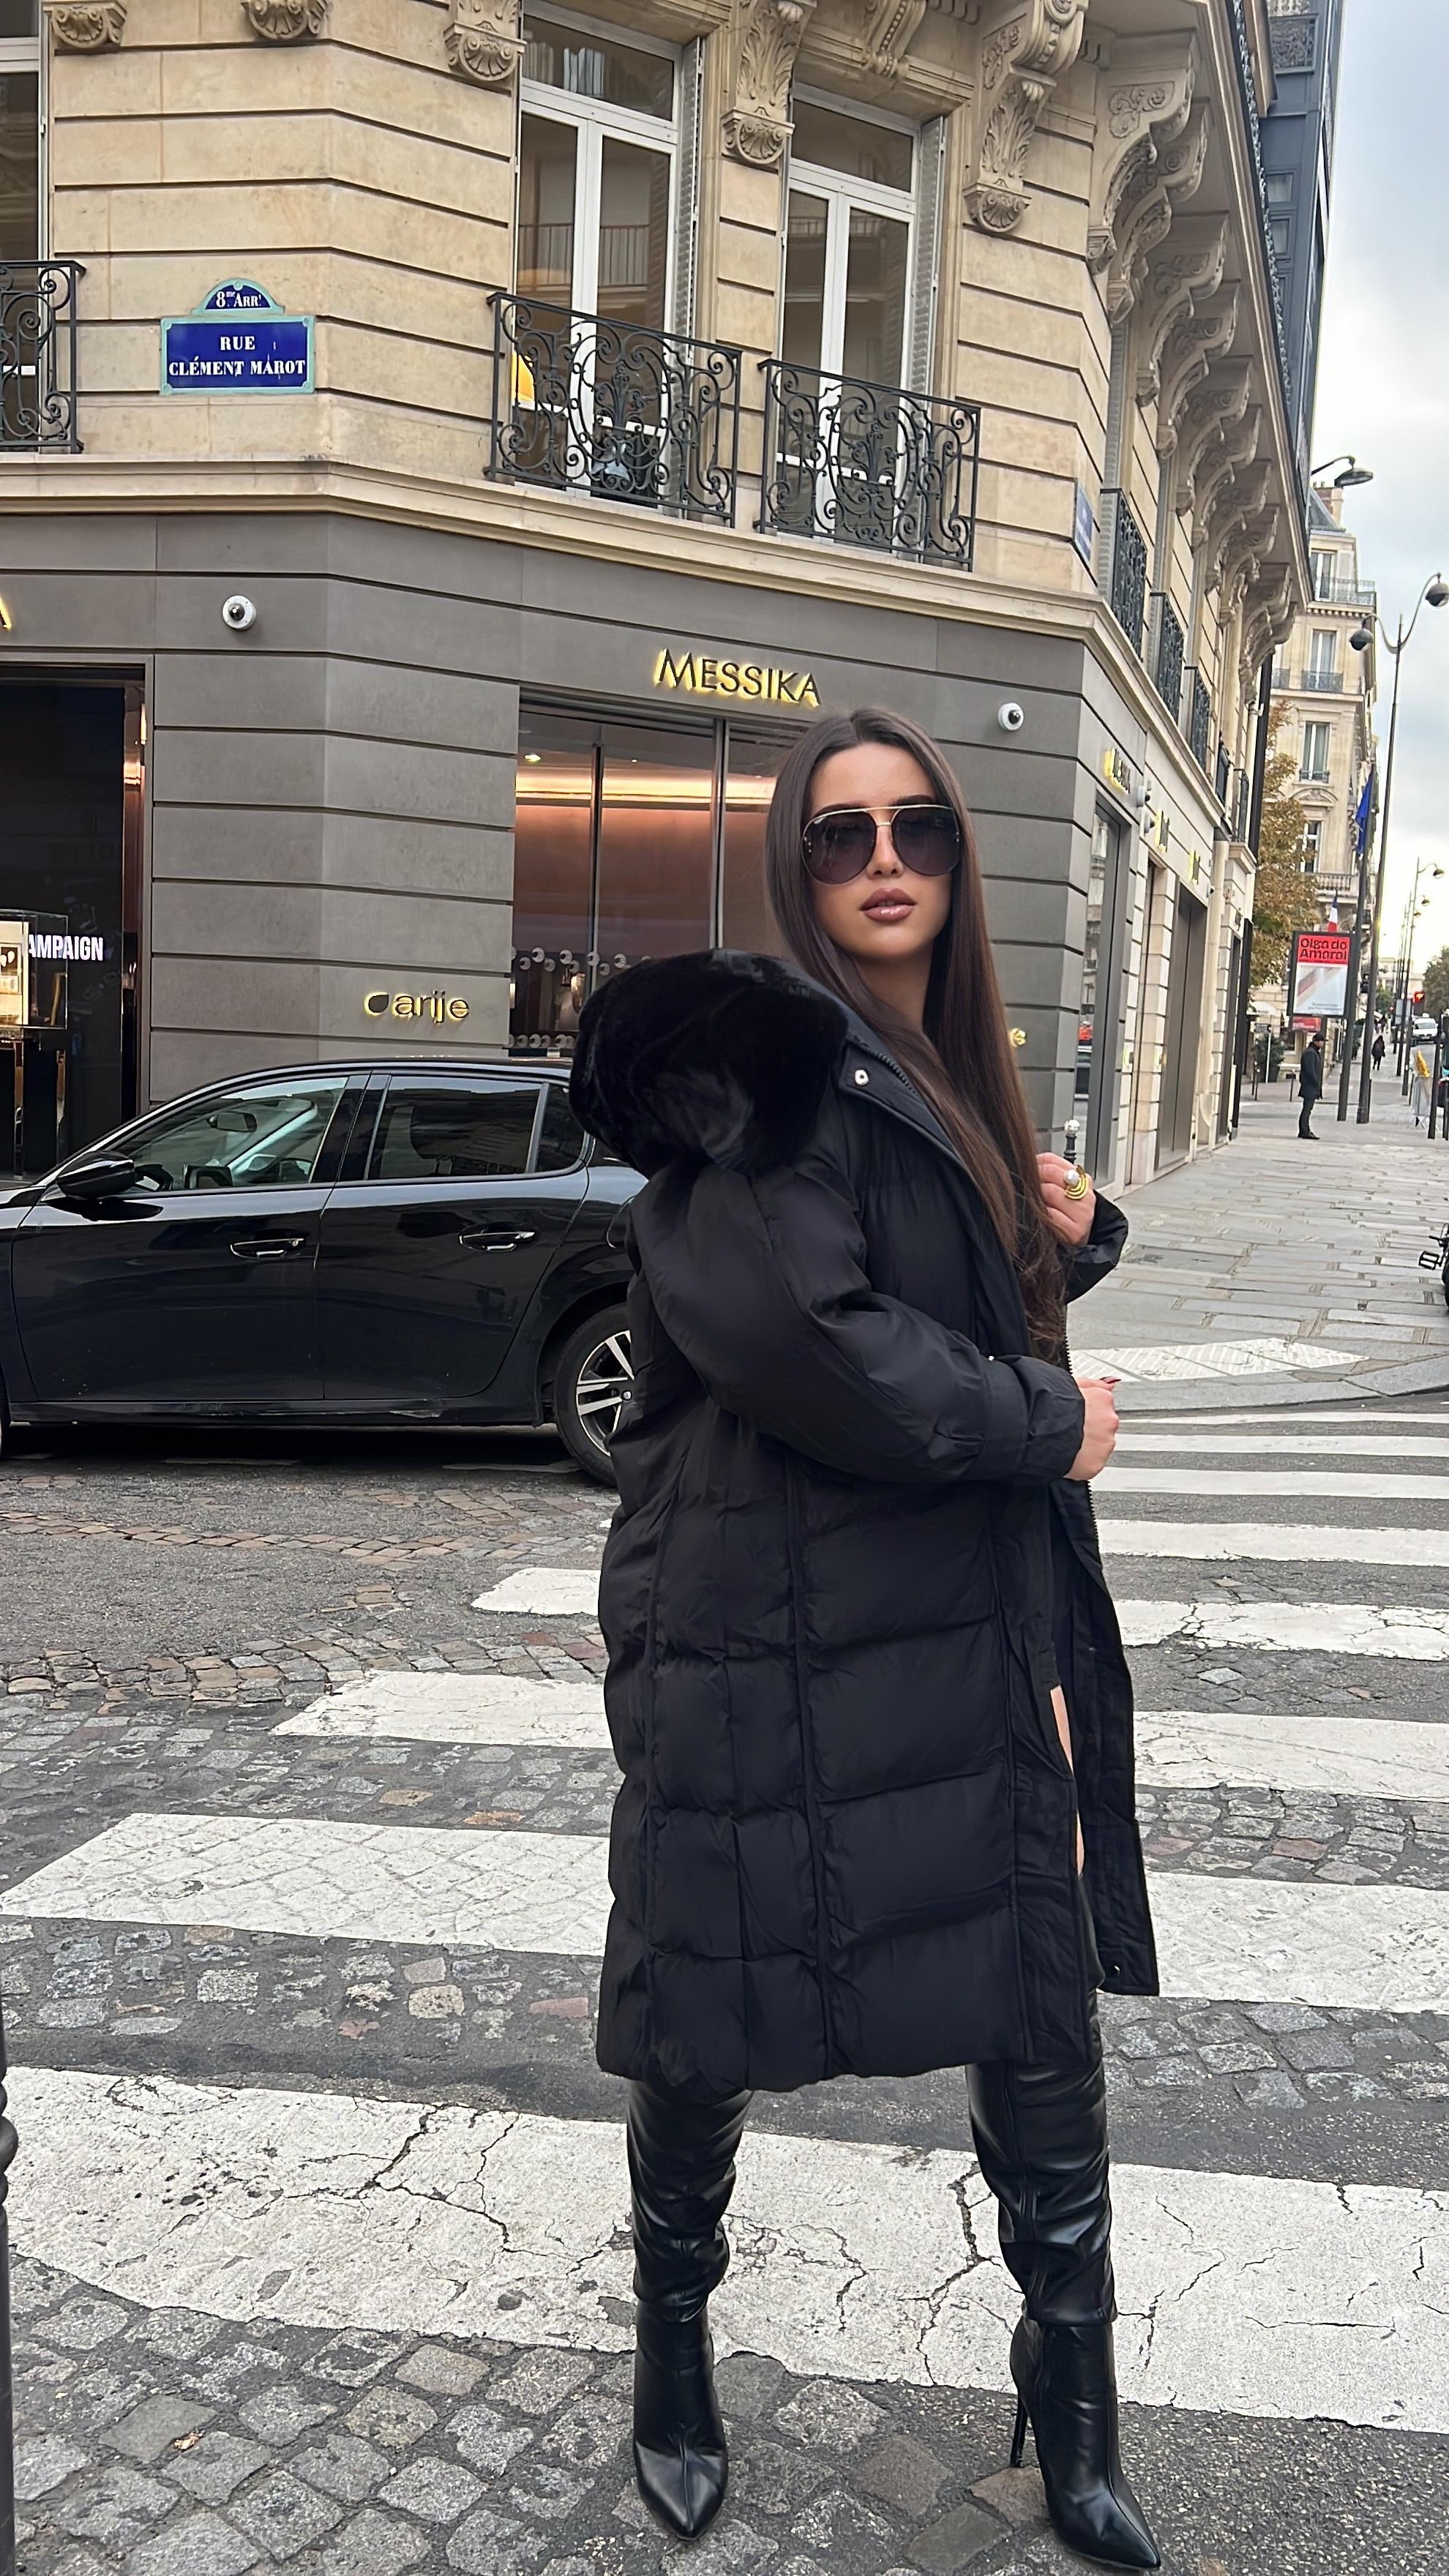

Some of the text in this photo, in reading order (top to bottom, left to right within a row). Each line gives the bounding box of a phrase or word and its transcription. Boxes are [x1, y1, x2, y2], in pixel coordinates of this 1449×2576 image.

[220, 336, 255, 351] RUE
[168, 356, 305, 376] CLÉMENT MAROT
[655, 648, 822, 708] MESSIKA
[393, 989, 470, 1025] arije
